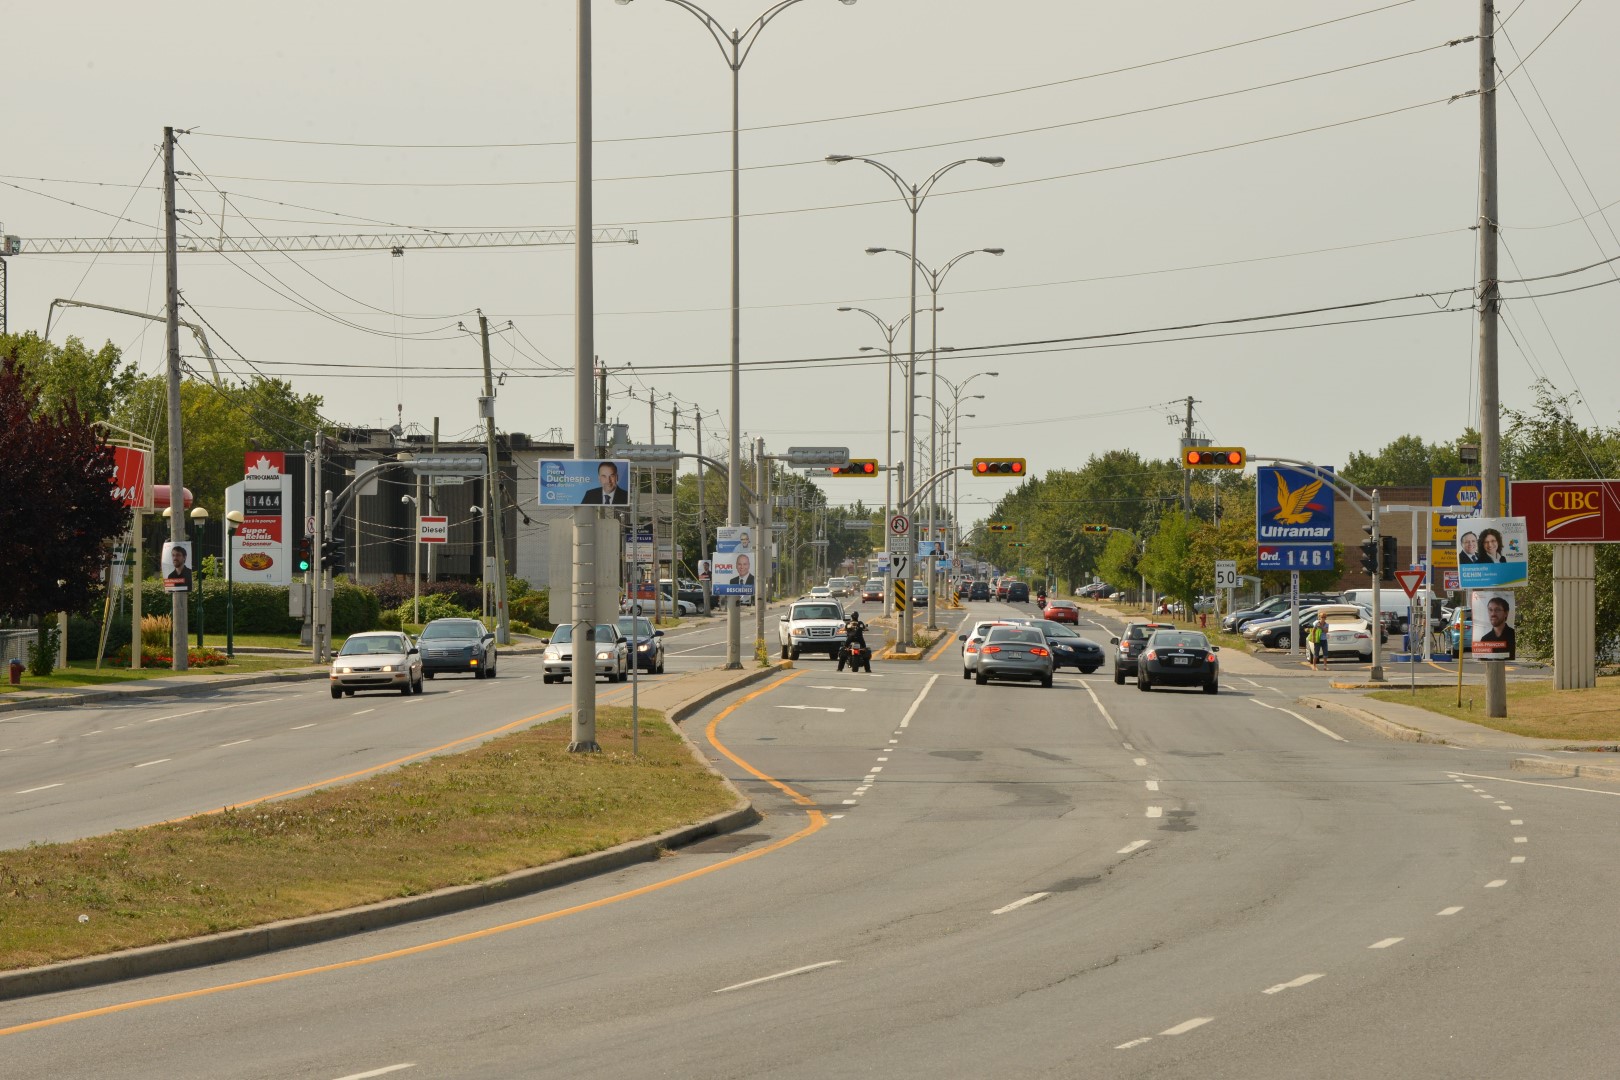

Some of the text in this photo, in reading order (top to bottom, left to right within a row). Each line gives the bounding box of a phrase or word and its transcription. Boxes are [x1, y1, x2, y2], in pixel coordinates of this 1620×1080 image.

[546, 475, 590, 483] Duchesne
[252, 496, 280, 506] 146.4
[1460, 491, 1478, 501] NAPA
[1548, 491, 1599, 510] CIBC
[242, 528, 267, 536] Super
[1261, 525, 1331, 537] Ultramar
[1260, 552, 1280, 561] Ord.
[1217, 571, 1235, 584] 50
